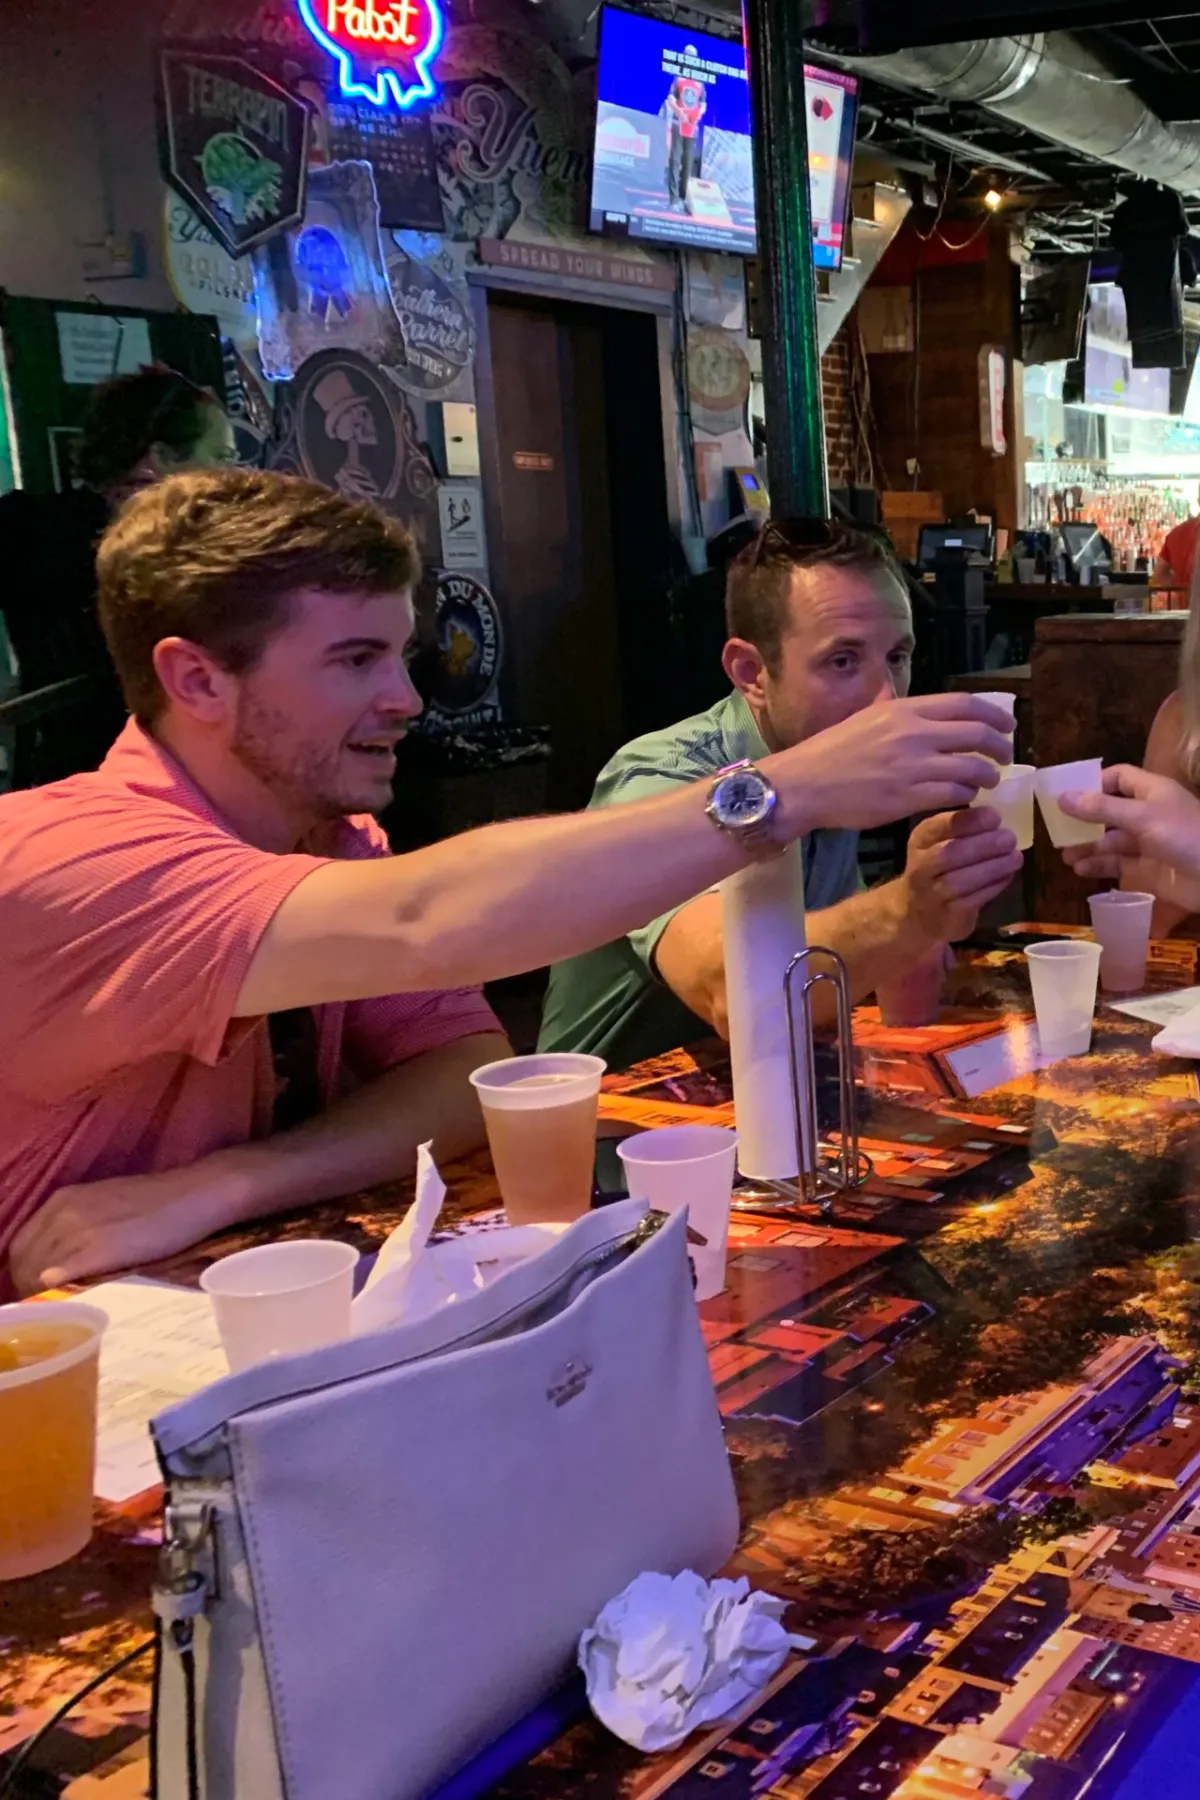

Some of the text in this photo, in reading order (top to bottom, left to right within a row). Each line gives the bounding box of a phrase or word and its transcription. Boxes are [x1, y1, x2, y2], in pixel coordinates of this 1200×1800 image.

[326, 0, 418, 44] Pabst
[499, 244, 654, 284] SPREAD YOUR WINGS
[446, 579, 475, 600] DU
[471, 592, 496, 677] MONDE
